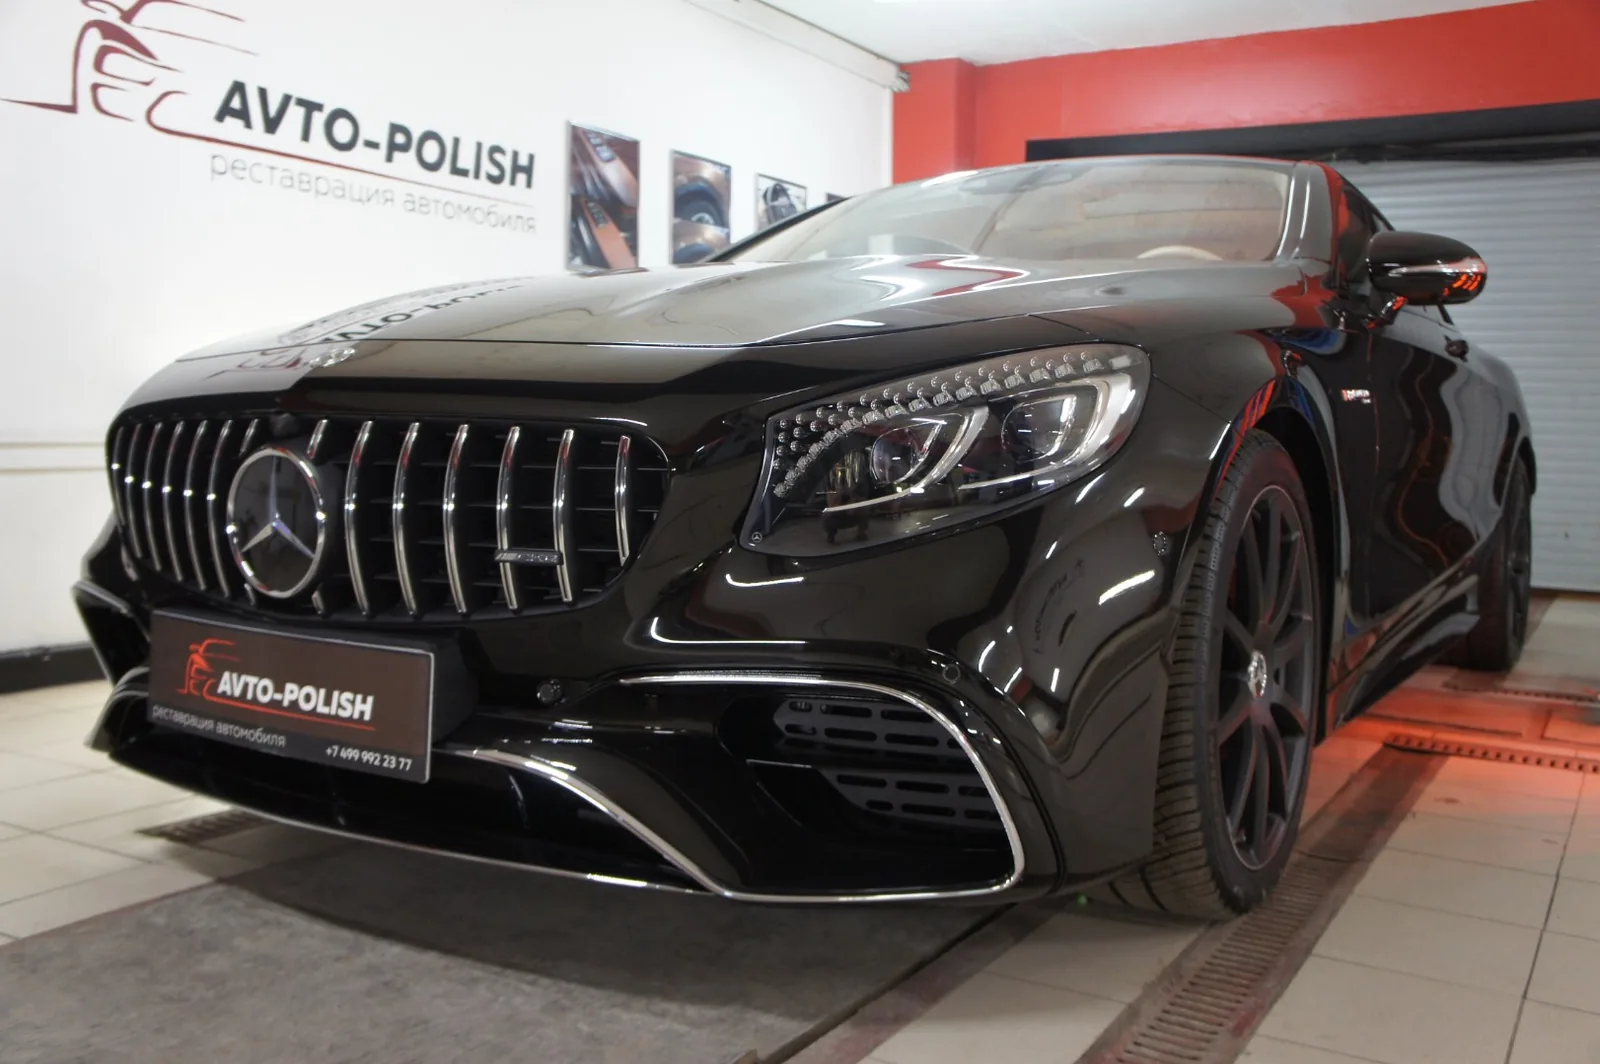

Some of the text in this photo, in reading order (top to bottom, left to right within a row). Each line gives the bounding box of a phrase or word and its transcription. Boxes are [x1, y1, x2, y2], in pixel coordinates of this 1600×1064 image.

[213, 80, 536, 189] AVTO-POLISH
[209, 154, 537, 234] реставрация автомобиля
[217, 670, 375, 722] AVTO-POLISH
[152, 705, 286, 748] реставрация автомобиля
[325, 745, 412, 771] +7 499 992 23 77
